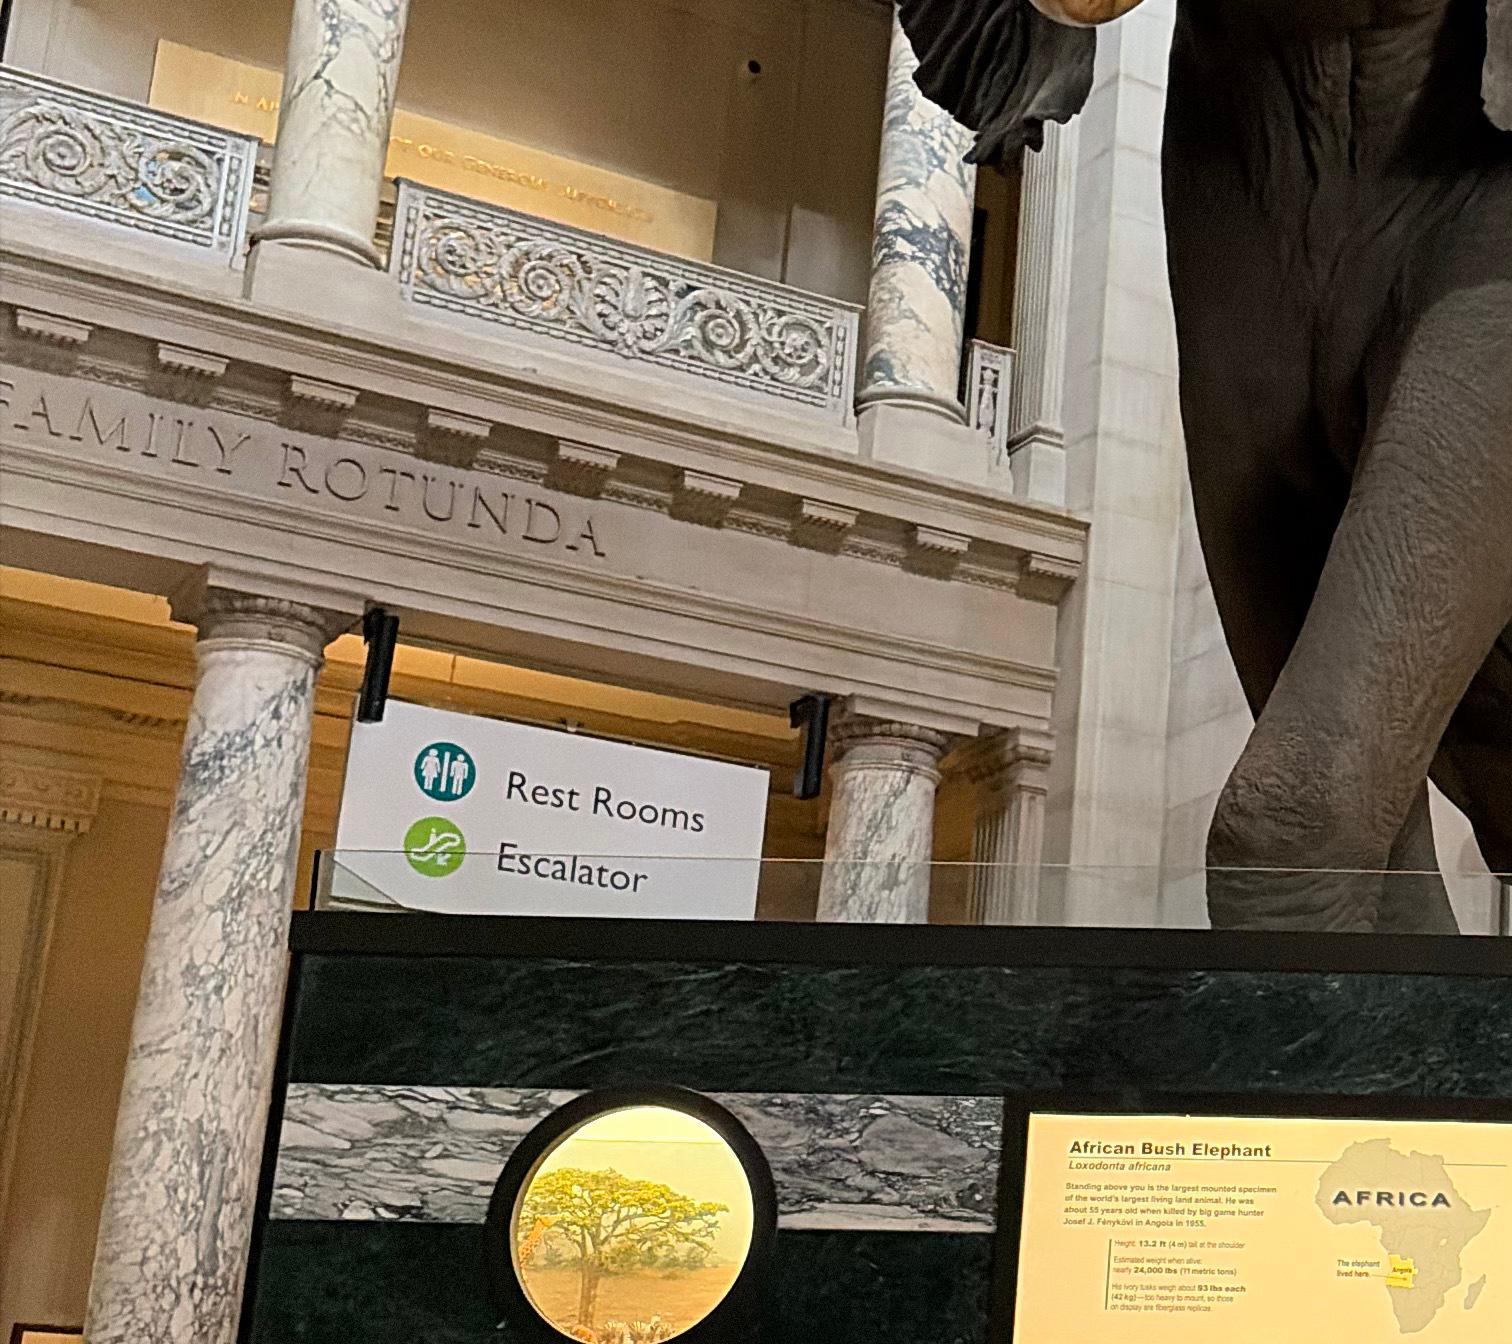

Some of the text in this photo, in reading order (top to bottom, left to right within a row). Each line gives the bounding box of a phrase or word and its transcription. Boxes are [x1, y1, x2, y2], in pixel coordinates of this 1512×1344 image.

[277, 442, 606, 558] ROTUNDA
[506, 771, 705, 832] Rest Rooms
[497, 843, 648, 893] Escalator
[1070, 1141, 1271, 1159] African Bush Elephant
[1069, 1160, 1171, 1172] Loxodonta africana
[1065, 1182, 1277, 1195] Standing above you is the largest mounted specimen
[1065, 1194, 1074, 1202] of
[1075, 1194, 1088, 1202] the
[1090, 1195, 1119, 1203] world's
[1121, 1195, 1149, 1205] largest
[1151, 1195, 1173, 1205] living
[1175, 1196, 1192, 1204] land
[1225, 1197, 1236, 1205] He
[1333, 1190, 1451, 1208] AFRICA
[1064, 1206, 1087, 1214] about
[1101, 1208, 1123, 1216] years
[1125, 1207, 1138, 1215] old
[1140, 1207, 1161, 1215] when
[1187, 1208, 1197, 1217] by
[1199, 1208, 1212, 1217] big
[1214, 1210, 1236, 1218] game
[1238, 1209, 1264, 1217] hunter
[1063, 1218, 1086, 1226] Josef
[1145, 1219, 1174, 1228] Angola
[1176, 1219, 1184, 1227] in
[1337, 1259, 1380, 1268] The elephant
[1134, 1267, 1163, 1275] 24,000
[1224, 1285, 1246, 1293] each
